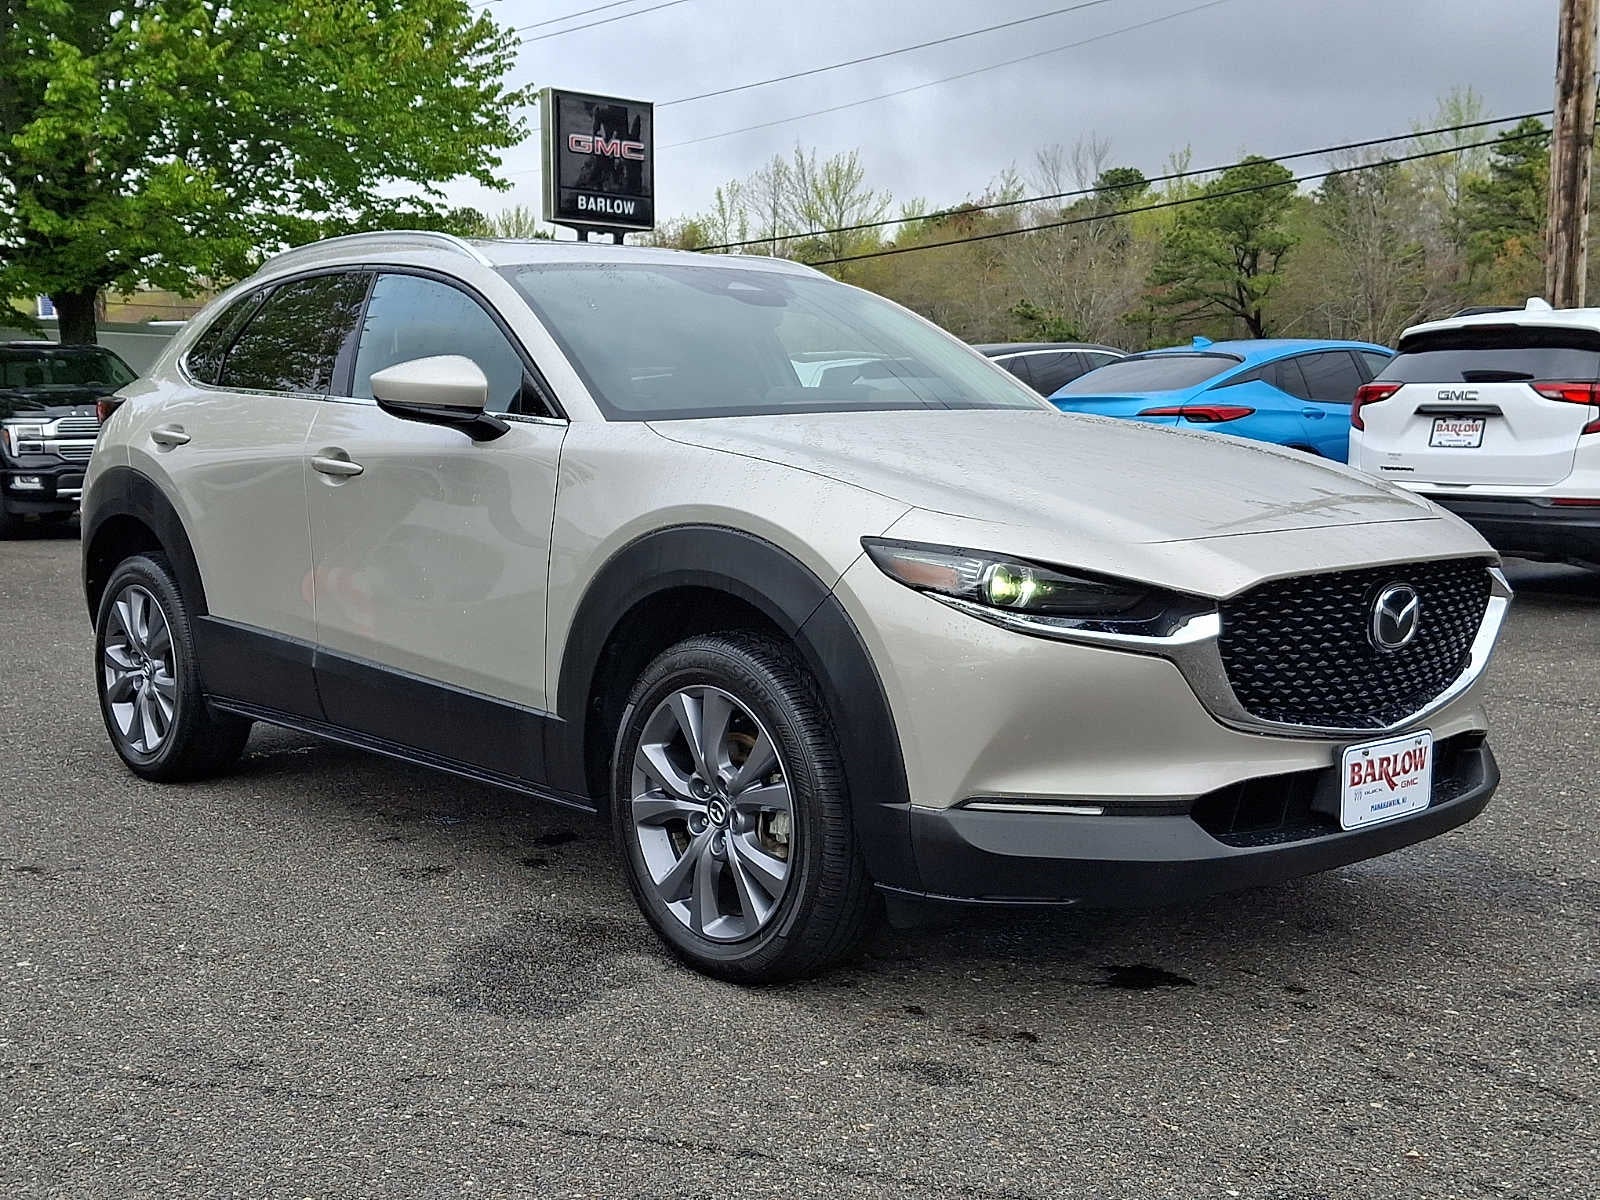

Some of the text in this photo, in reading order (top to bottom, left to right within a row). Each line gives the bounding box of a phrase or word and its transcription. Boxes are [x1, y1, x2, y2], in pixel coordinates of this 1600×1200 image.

[569, 133, 645, 161] GMC
[577, 195, 635, 215] BARLOW
[1437, 390, 1479, 401] GMC
[1435, 423, 1481, 436] BARLOW
[1349, 746, 1427, 791] BARLOW
[1400, 777, 1418, 789] GMC
